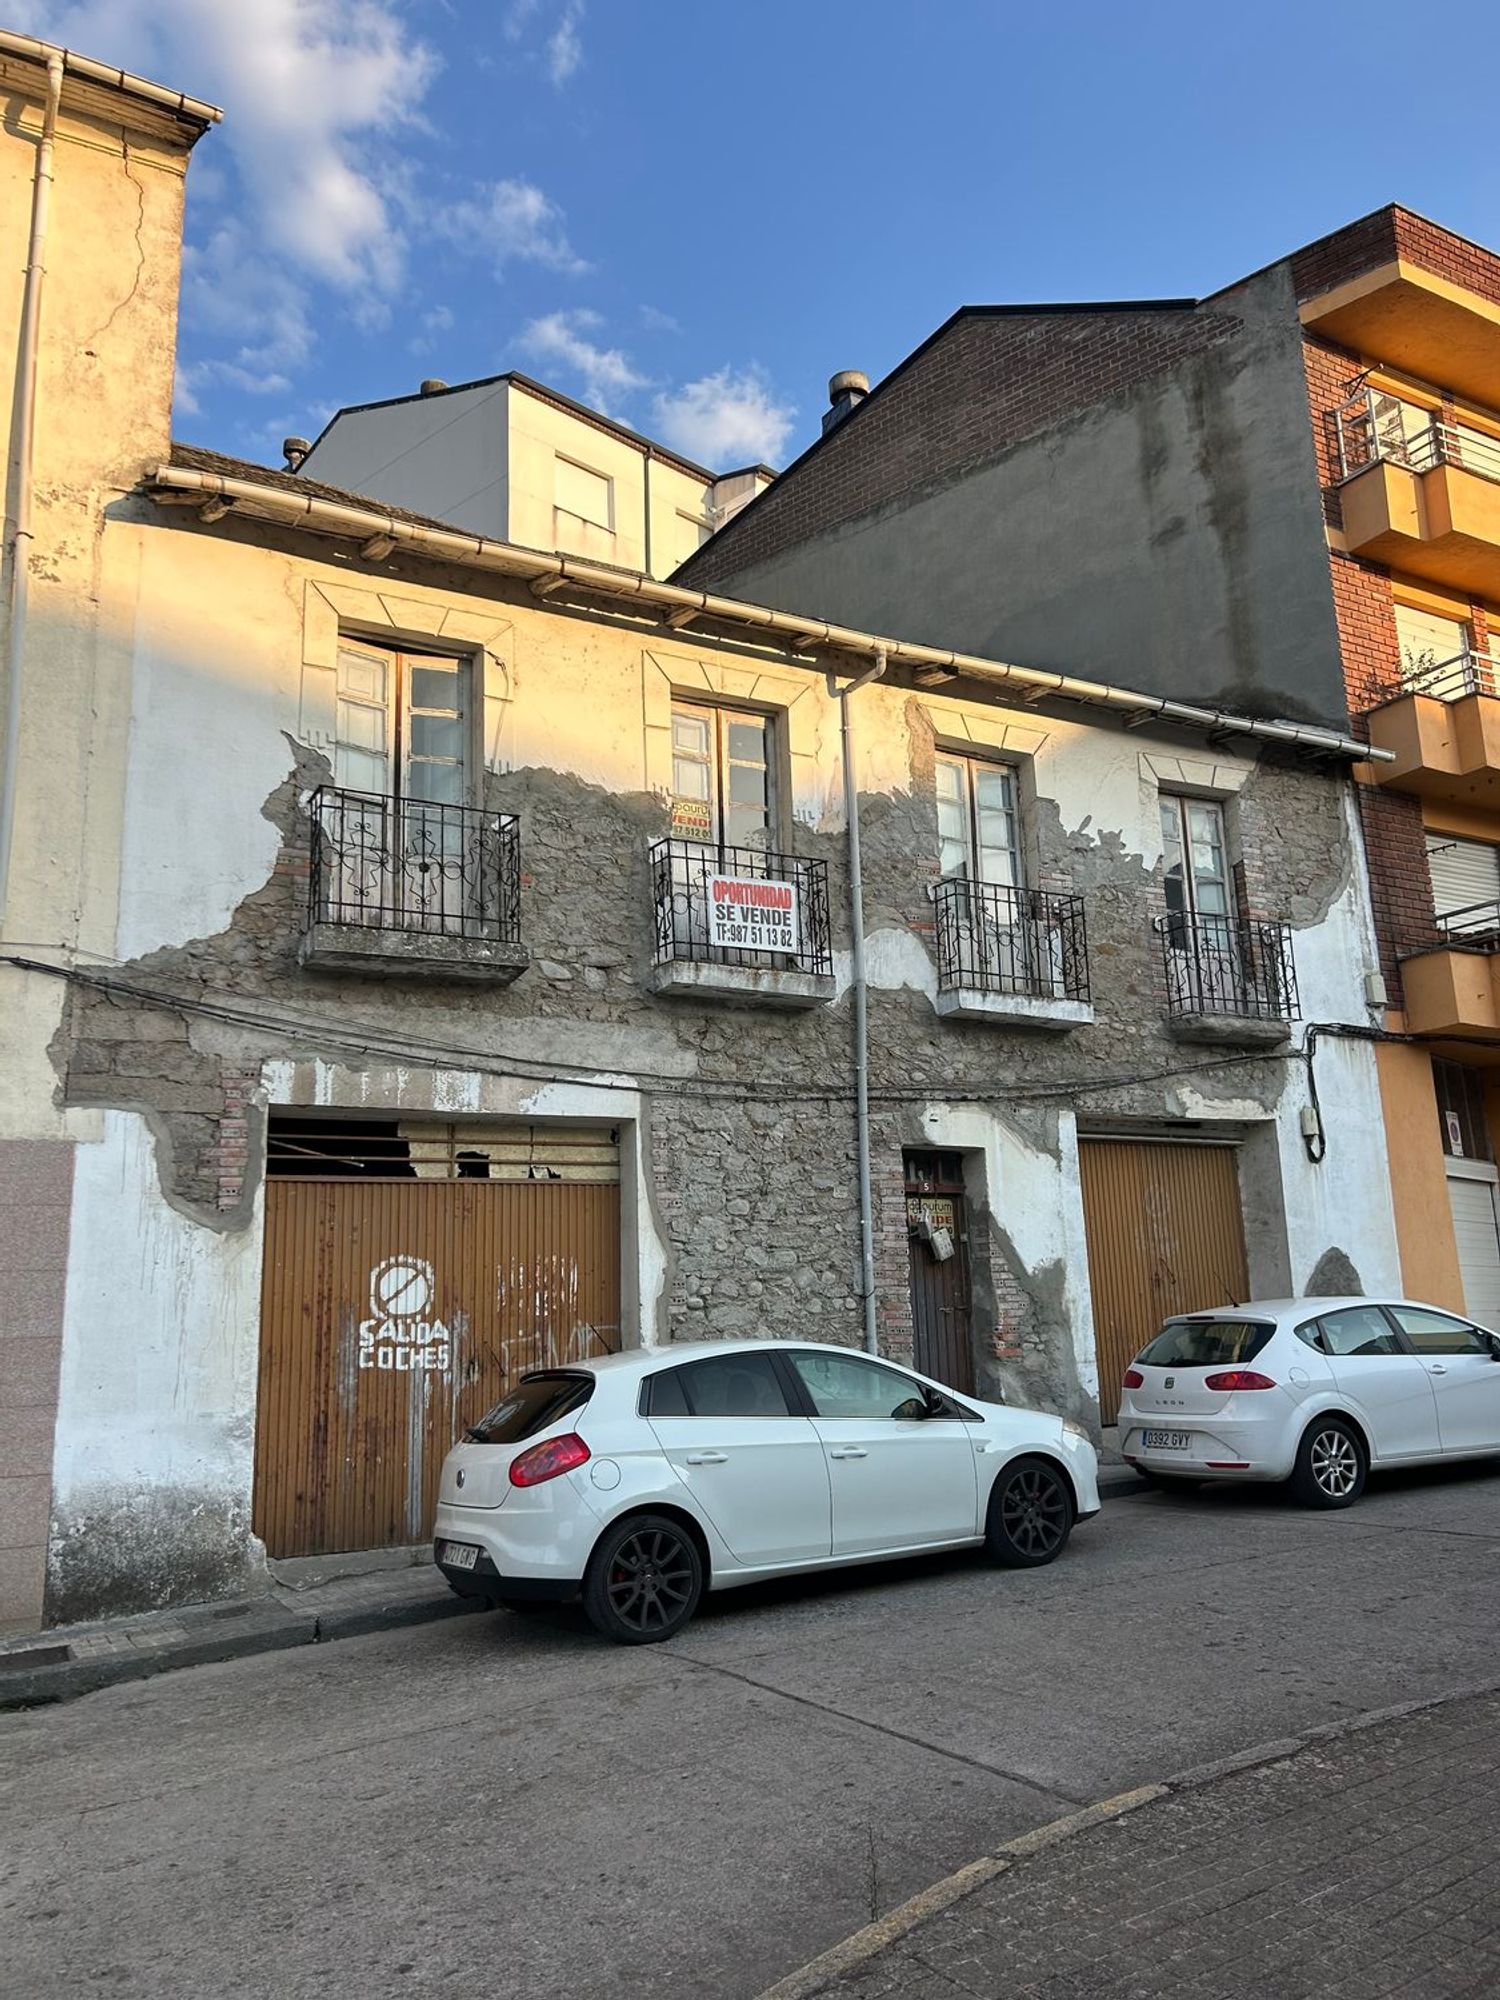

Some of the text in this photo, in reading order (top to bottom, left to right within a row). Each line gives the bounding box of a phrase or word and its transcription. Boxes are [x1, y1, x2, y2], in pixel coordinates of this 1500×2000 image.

[713, 880, 792, 910] OPORTUNIDAD
[715, 904, 792, 927] SE VENDE
[716, 922, 793, 947] TF:987 51 13 82
[923, 1183, 929, 1191] 5
[359, 1317, 449, 1347] SALIDA
[359, 1344, 449, 1371] COCHES
[1171, 1432, 1191, 1447] GVY
